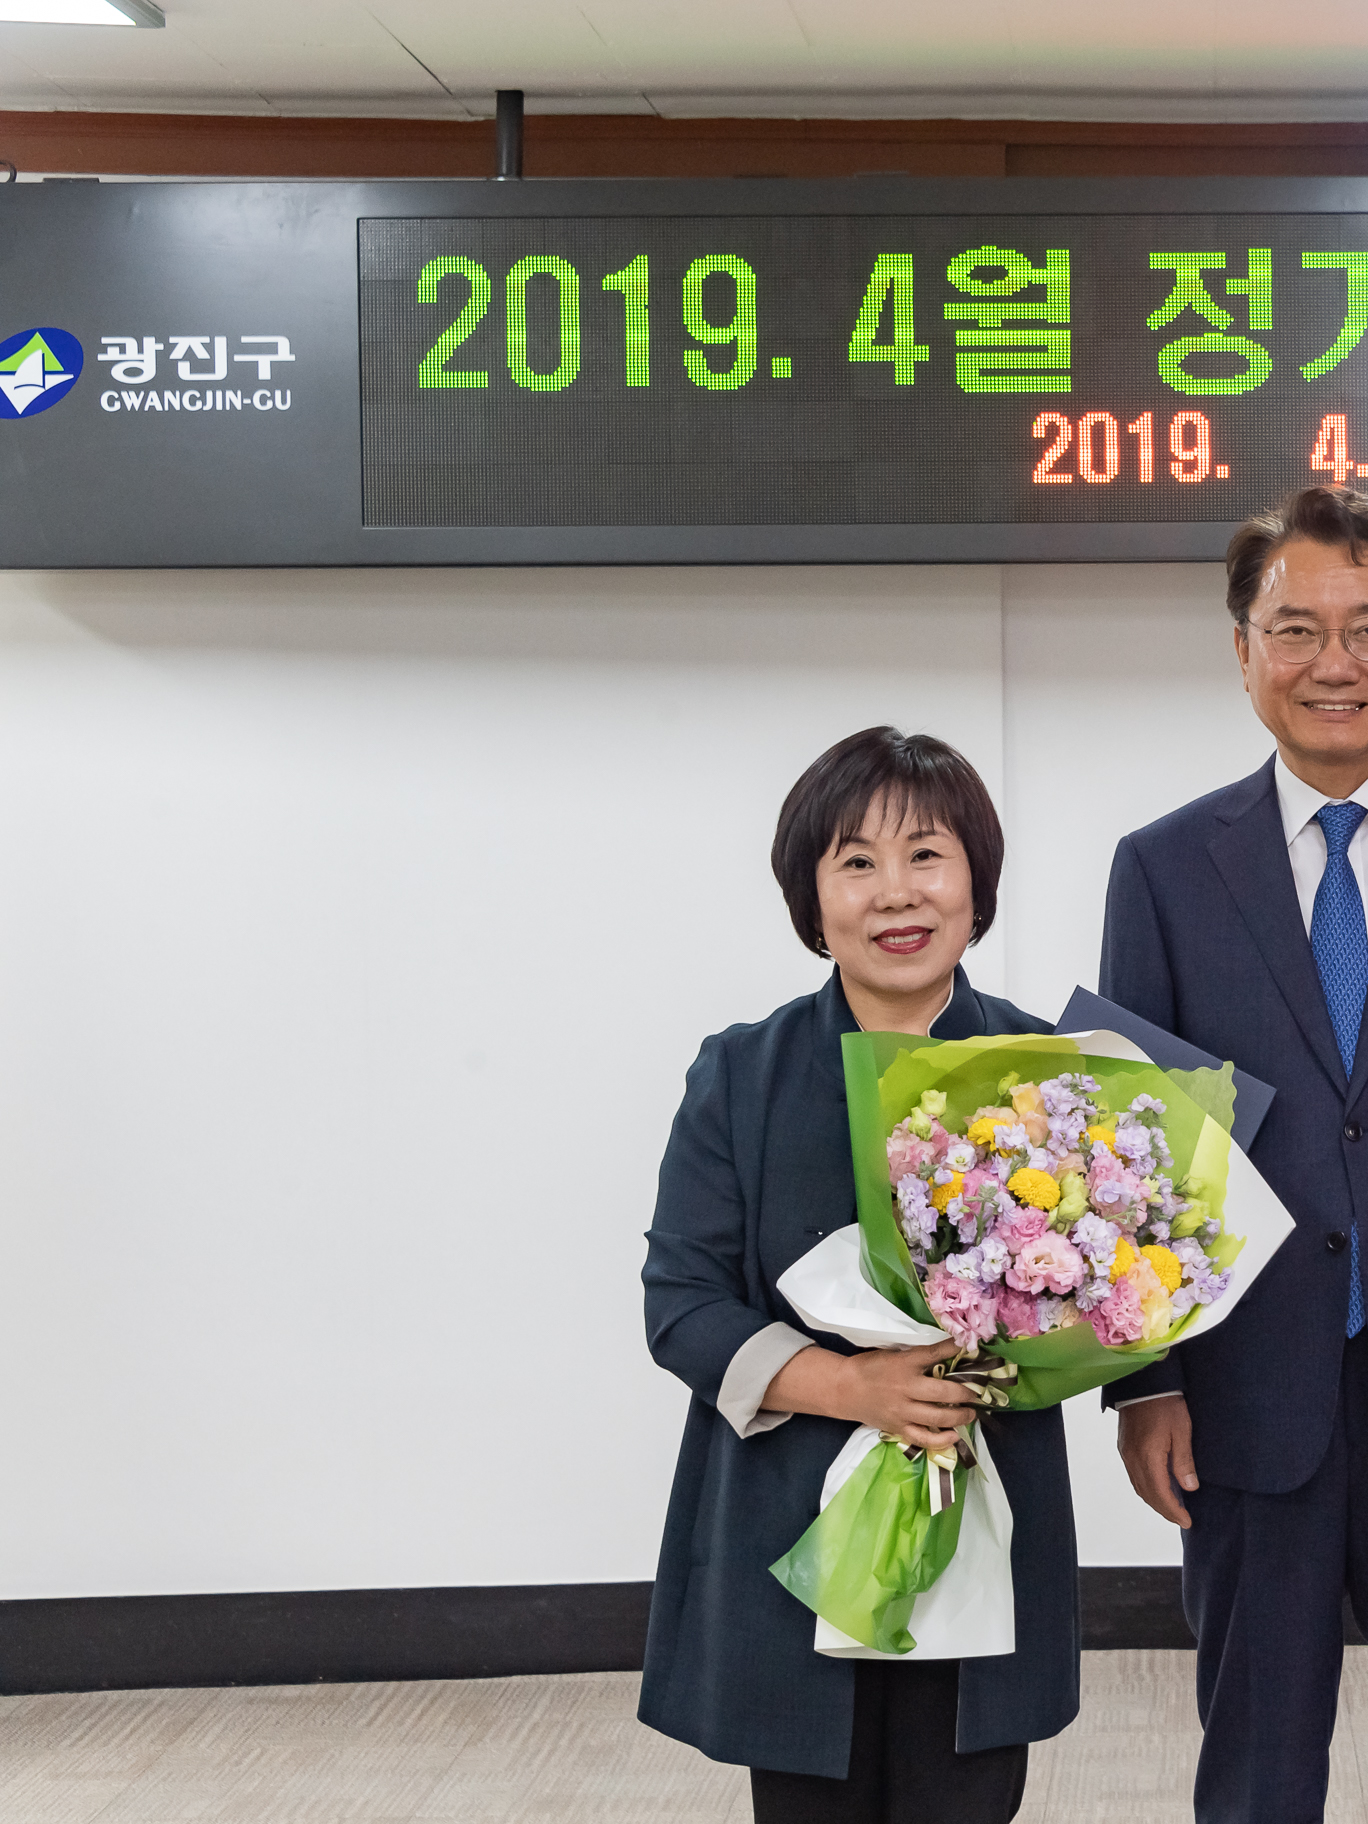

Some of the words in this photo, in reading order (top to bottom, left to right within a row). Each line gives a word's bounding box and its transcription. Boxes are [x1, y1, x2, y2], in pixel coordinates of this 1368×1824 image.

[418, 254, 791, 391] 2019.
[849, 246, 1071, 393] 4월
[97, 335, 296, 385] 광진구
[100, 389, 292, 412] GWANGJIN-GU
[1032, 411, 1230, 485] 2019.
